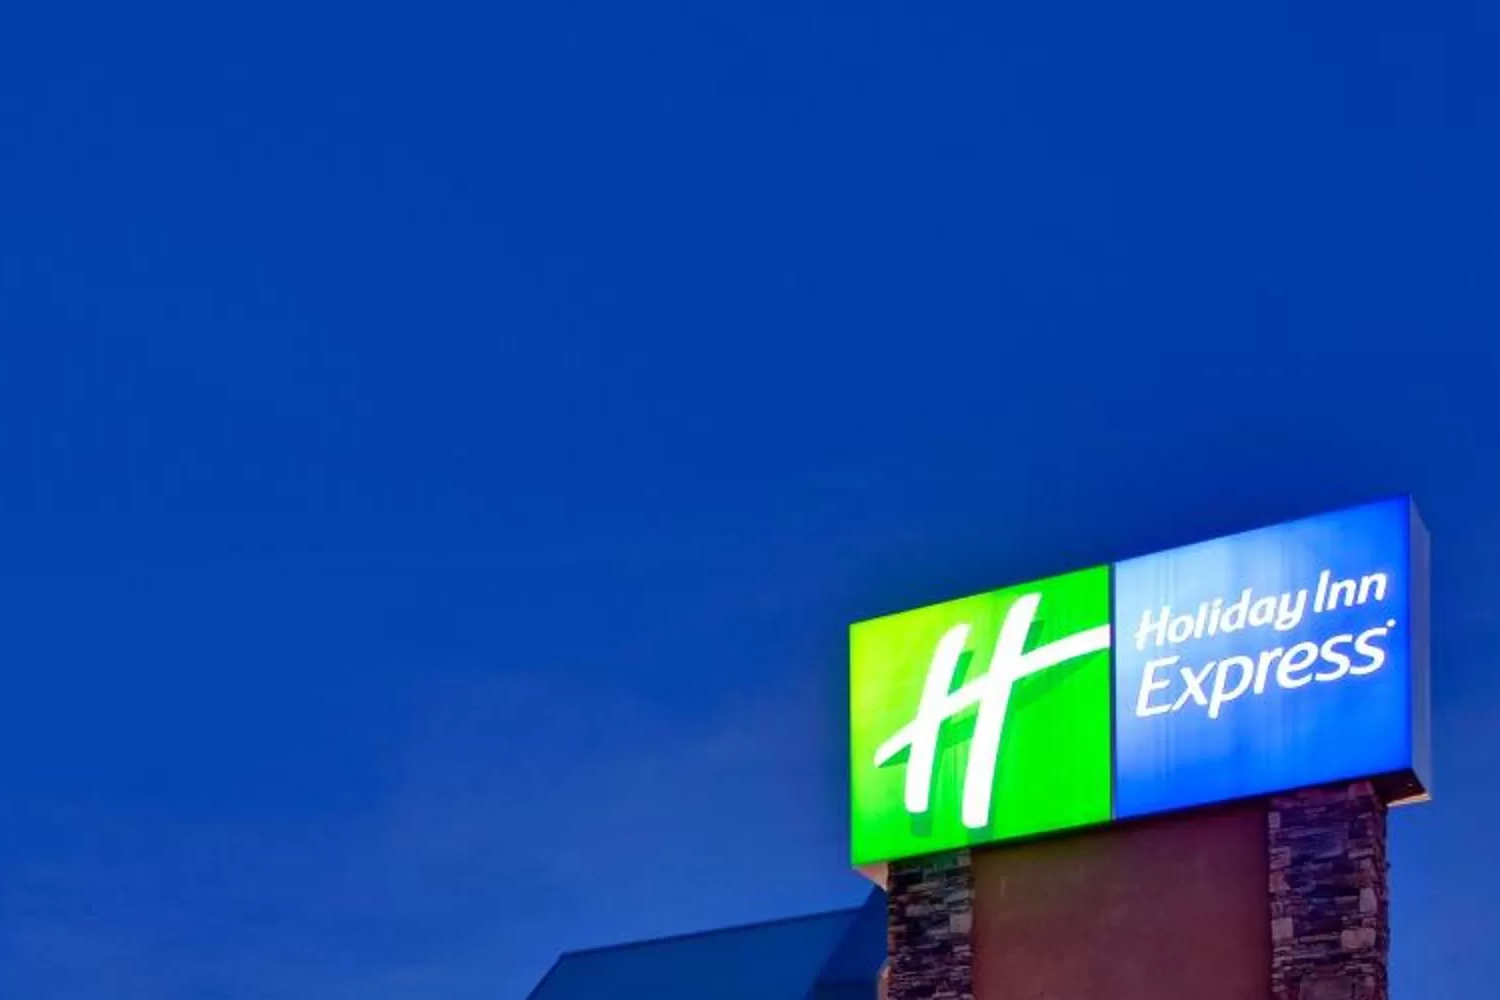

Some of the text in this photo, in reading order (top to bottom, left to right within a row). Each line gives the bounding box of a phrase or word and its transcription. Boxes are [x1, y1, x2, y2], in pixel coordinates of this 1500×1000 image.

[1134, 569, 1388, 651] Holiday Inn
[1135, 623, 1392, 720] Express
